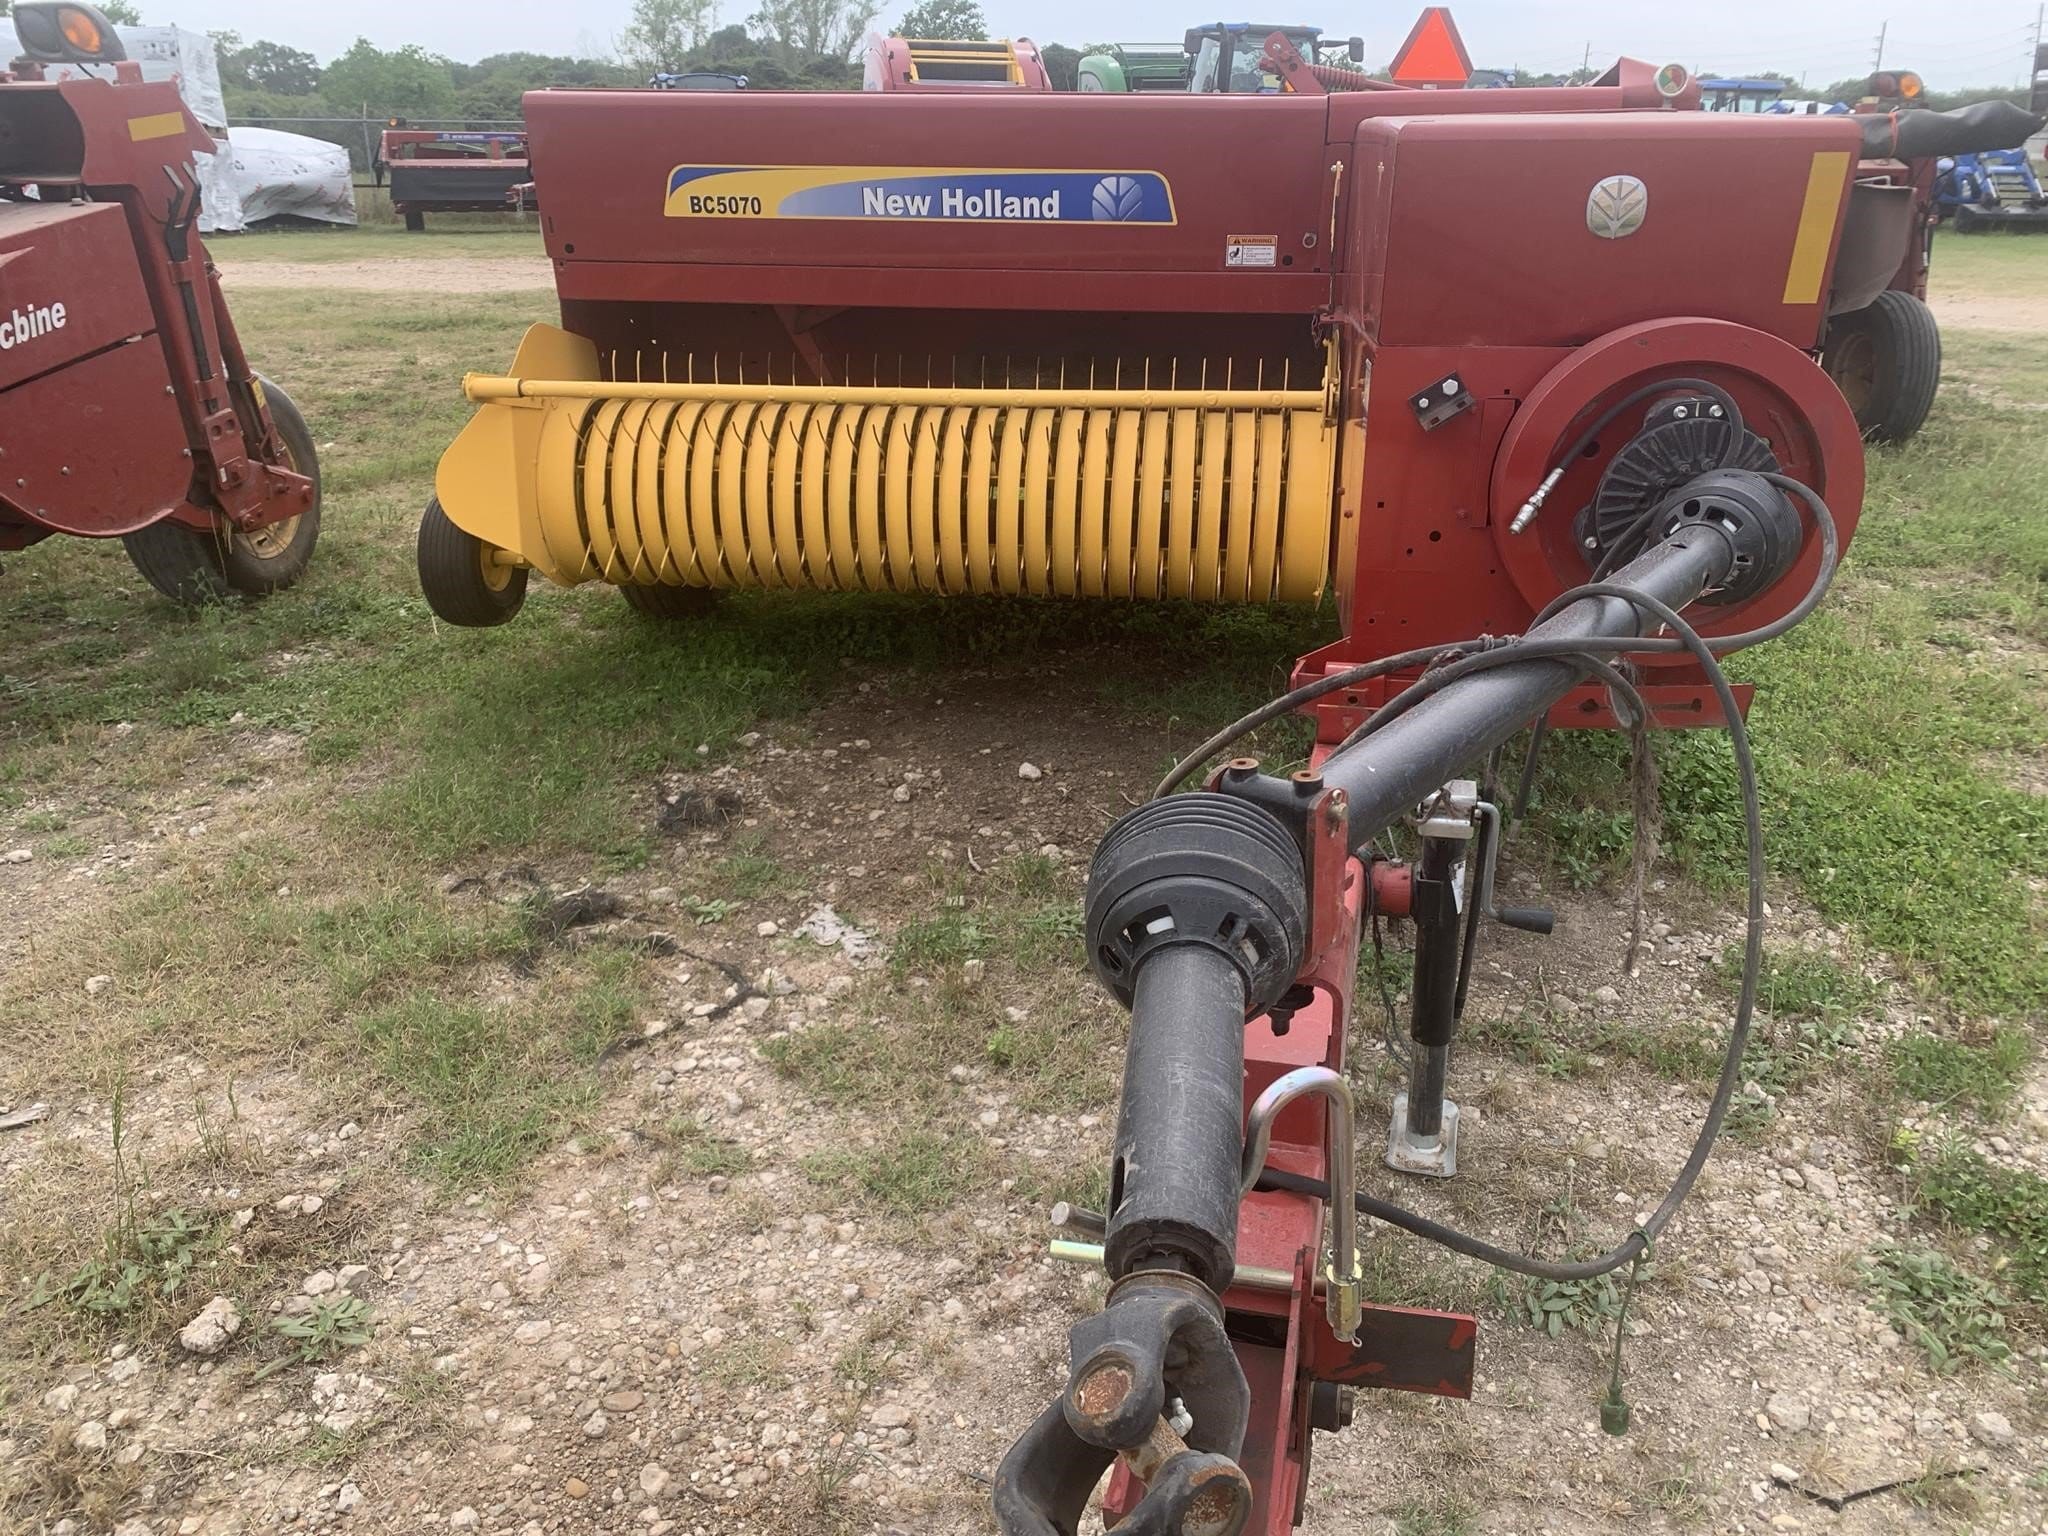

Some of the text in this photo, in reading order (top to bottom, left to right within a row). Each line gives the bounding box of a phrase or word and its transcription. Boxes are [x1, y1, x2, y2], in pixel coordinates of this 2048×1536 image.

[690, 187, 1060, 219] BC5070 New Holland
[0, 302, 67, 350] cbine
